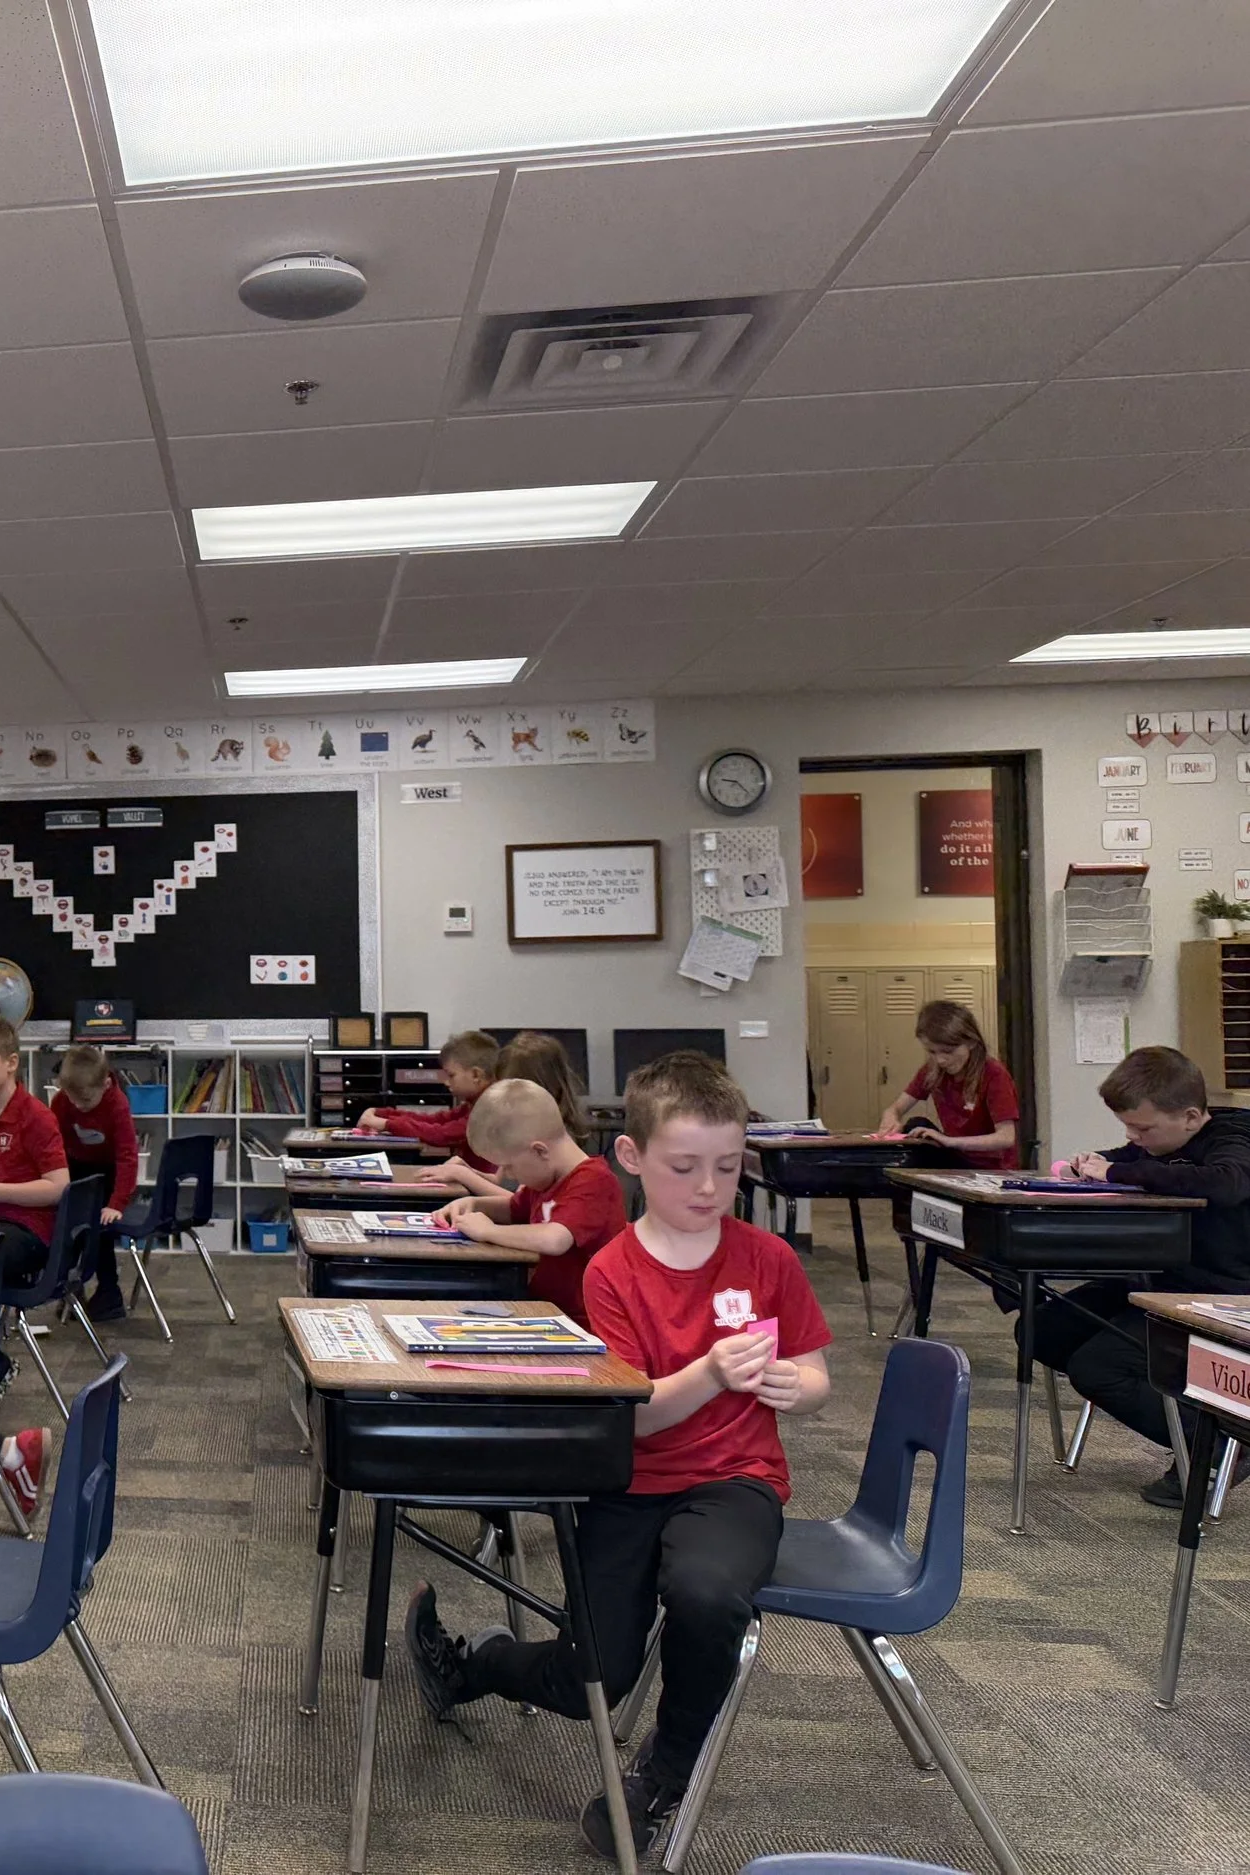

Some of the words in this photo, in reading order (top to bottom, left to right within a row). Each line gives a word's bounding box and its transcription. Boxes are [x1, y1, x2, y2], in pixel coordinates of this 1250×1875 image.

[558, 710, 576, 722] Yy
[610, 706, 628, 719] Zz
[308, 720, 323, 731] Tt
[355, 719, 374, 729] Uu
[406, 716, 425, 726] Vv
[456, 715, 482, 725] Ww
[117, 728, 134, 739] Pp
[164, 725, 183, 738] Qq
[211, 724, 225, 735] Rr
[258, 723, 275, 734] Ss
[25, 731, 44, 741] Nn
[71, 730, 91, 741] Oo
[1103, 765, 1141, 777] JANUARY
[1171, 762, 1211, 775] FEBRUARY
[414, 786, 449, 799] West
[950, 819, 972, 828] And
[942, 832, 984, 841] whether
[1114, 827, 1139, 841] JUNE
[940, 844, 956, 853] do
[960, 844, 970, 853] it
[974, 844, 992, 853] all
[950, 856, 965, 866] of
[967, 856, 989, 865] the
[583, 907, 605, 915] 14:6
[923, 1207, 948, 1232] Mack
[725, 1298, 742, 1314] H
[715, 1314, 756, 1326] HILLCREST
